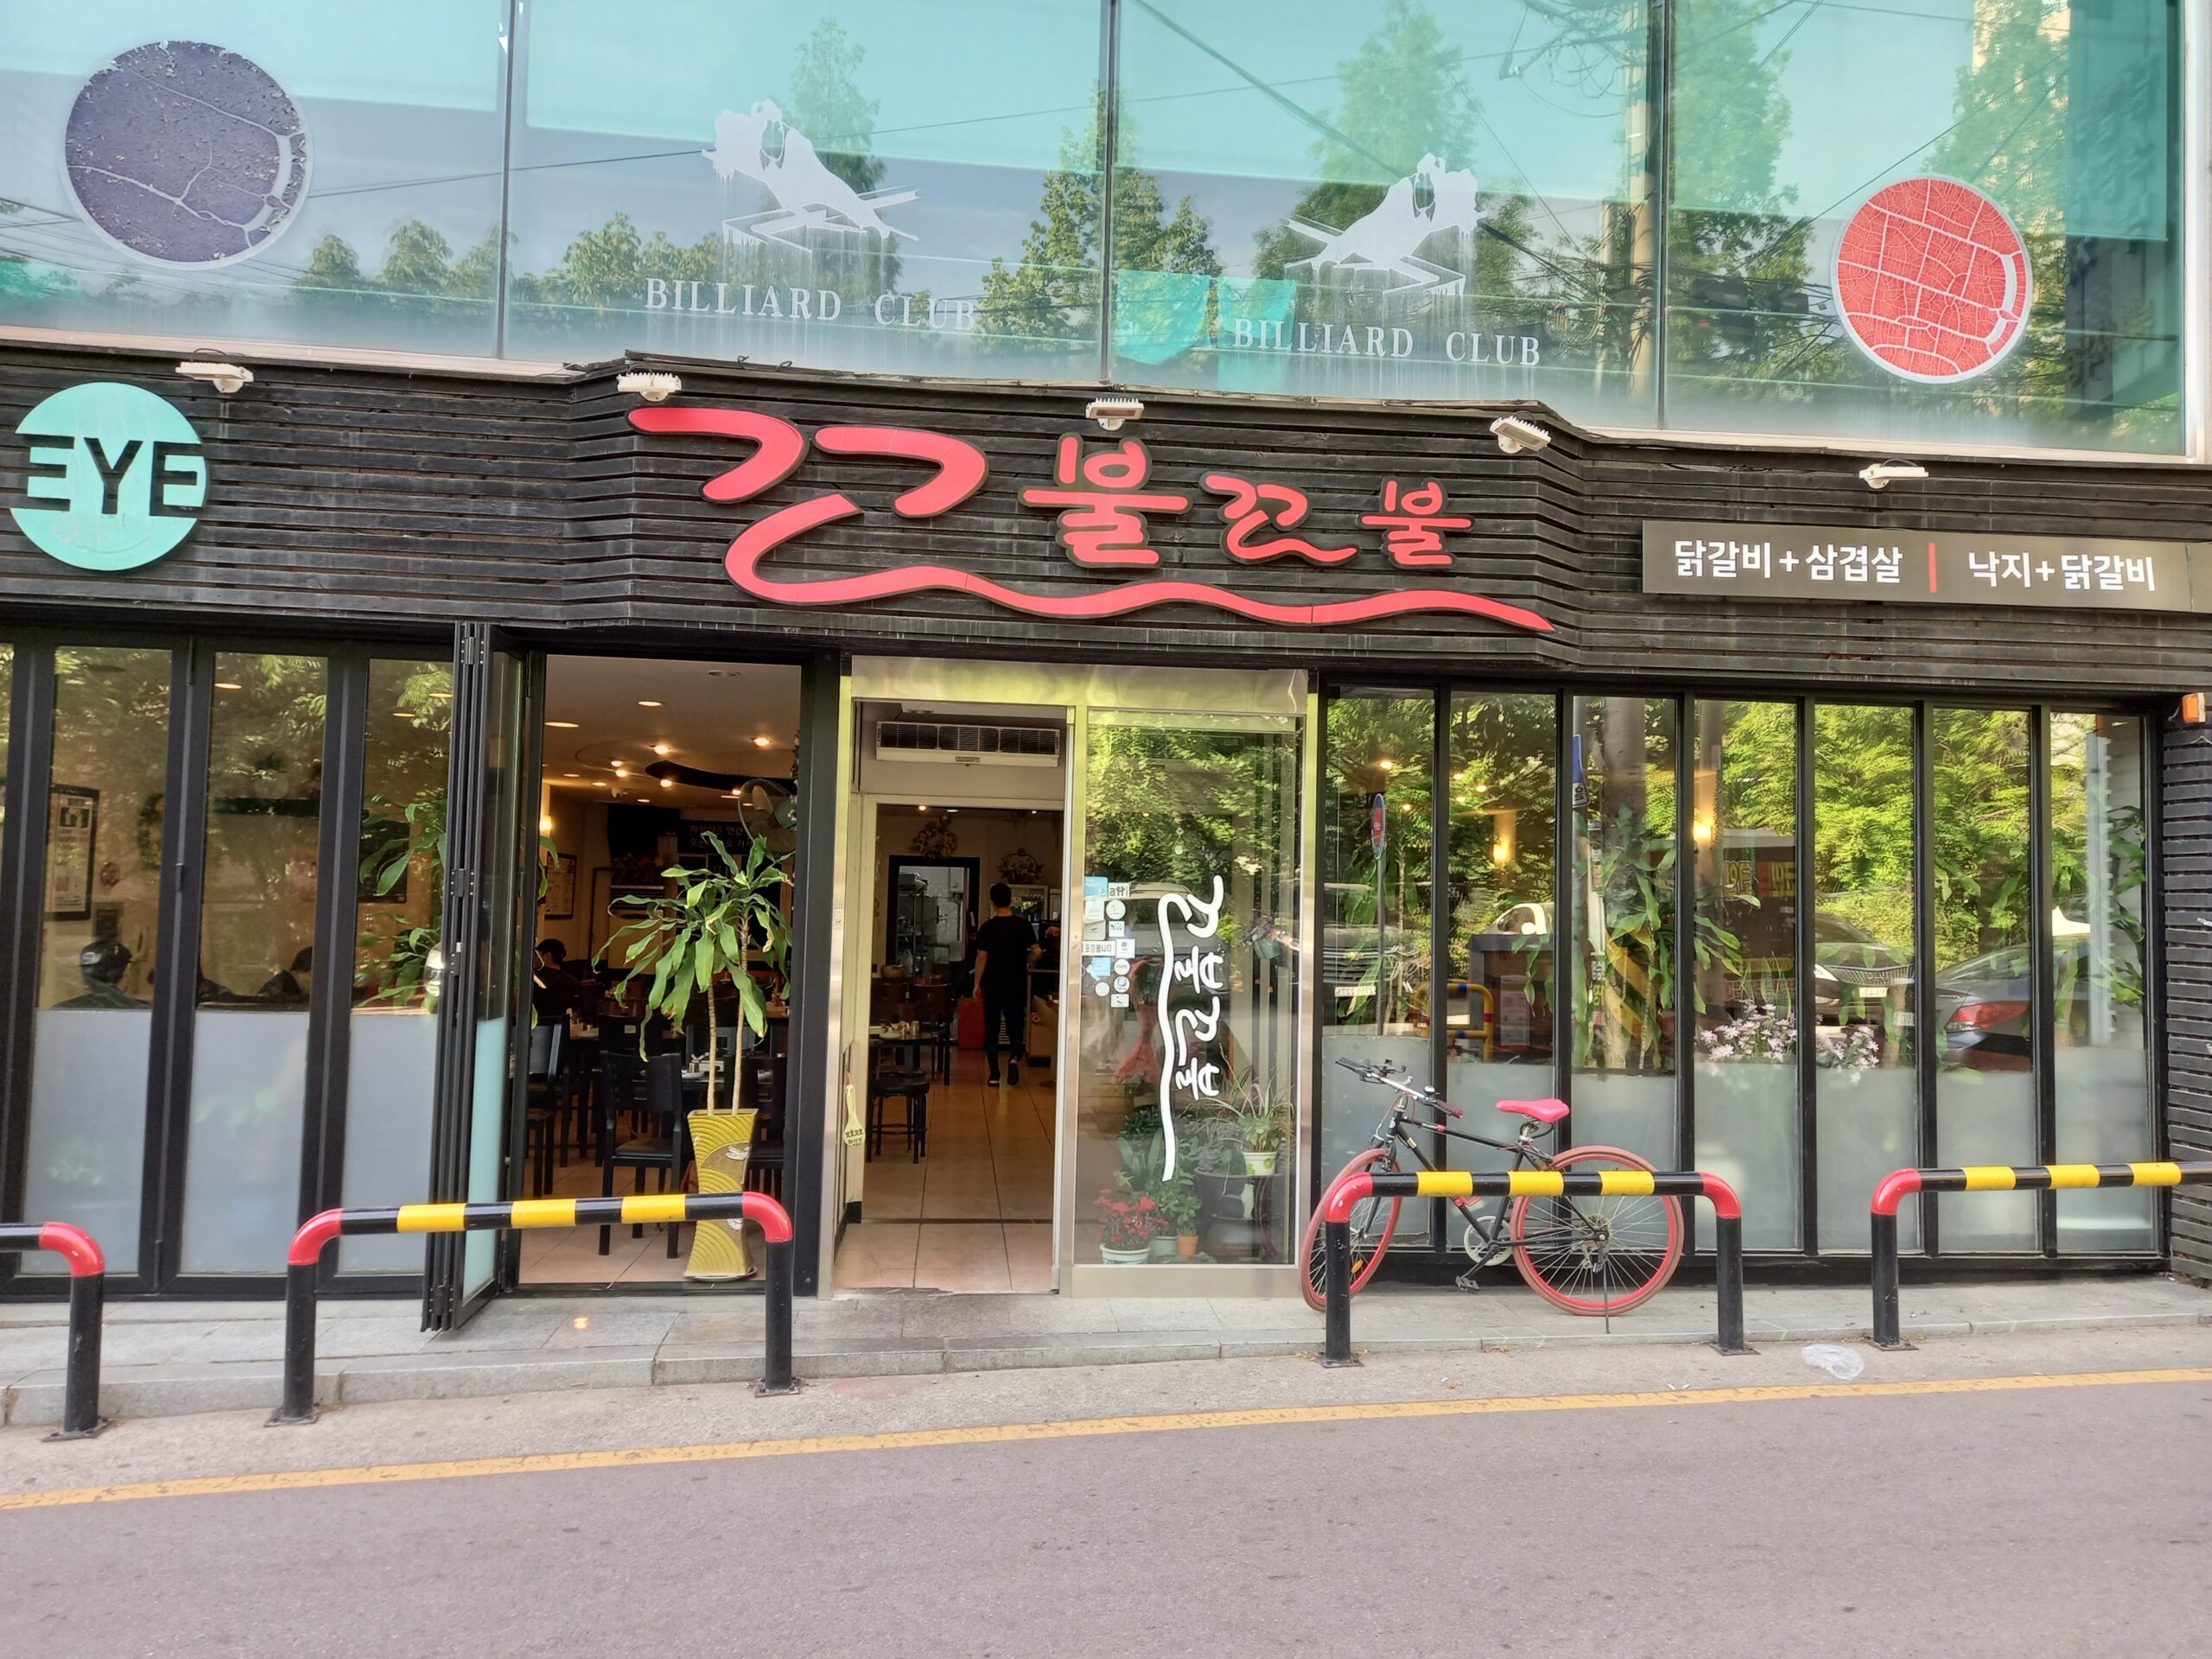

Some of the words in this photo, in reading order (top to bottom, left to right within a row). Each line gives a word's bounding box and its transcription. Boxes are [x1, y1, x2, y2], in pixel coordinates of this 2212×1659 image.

[645, 276, 842, 323] BILLIARD
[874, 294, 976, 332] CLUB
[1232, 317, 1414, 359] BILLIARD
[1446, 330, 1541, 367] CLUB
[10, 432, 207, 518] EYE
[1084, 944, 1112, 953] 포장됩니다
